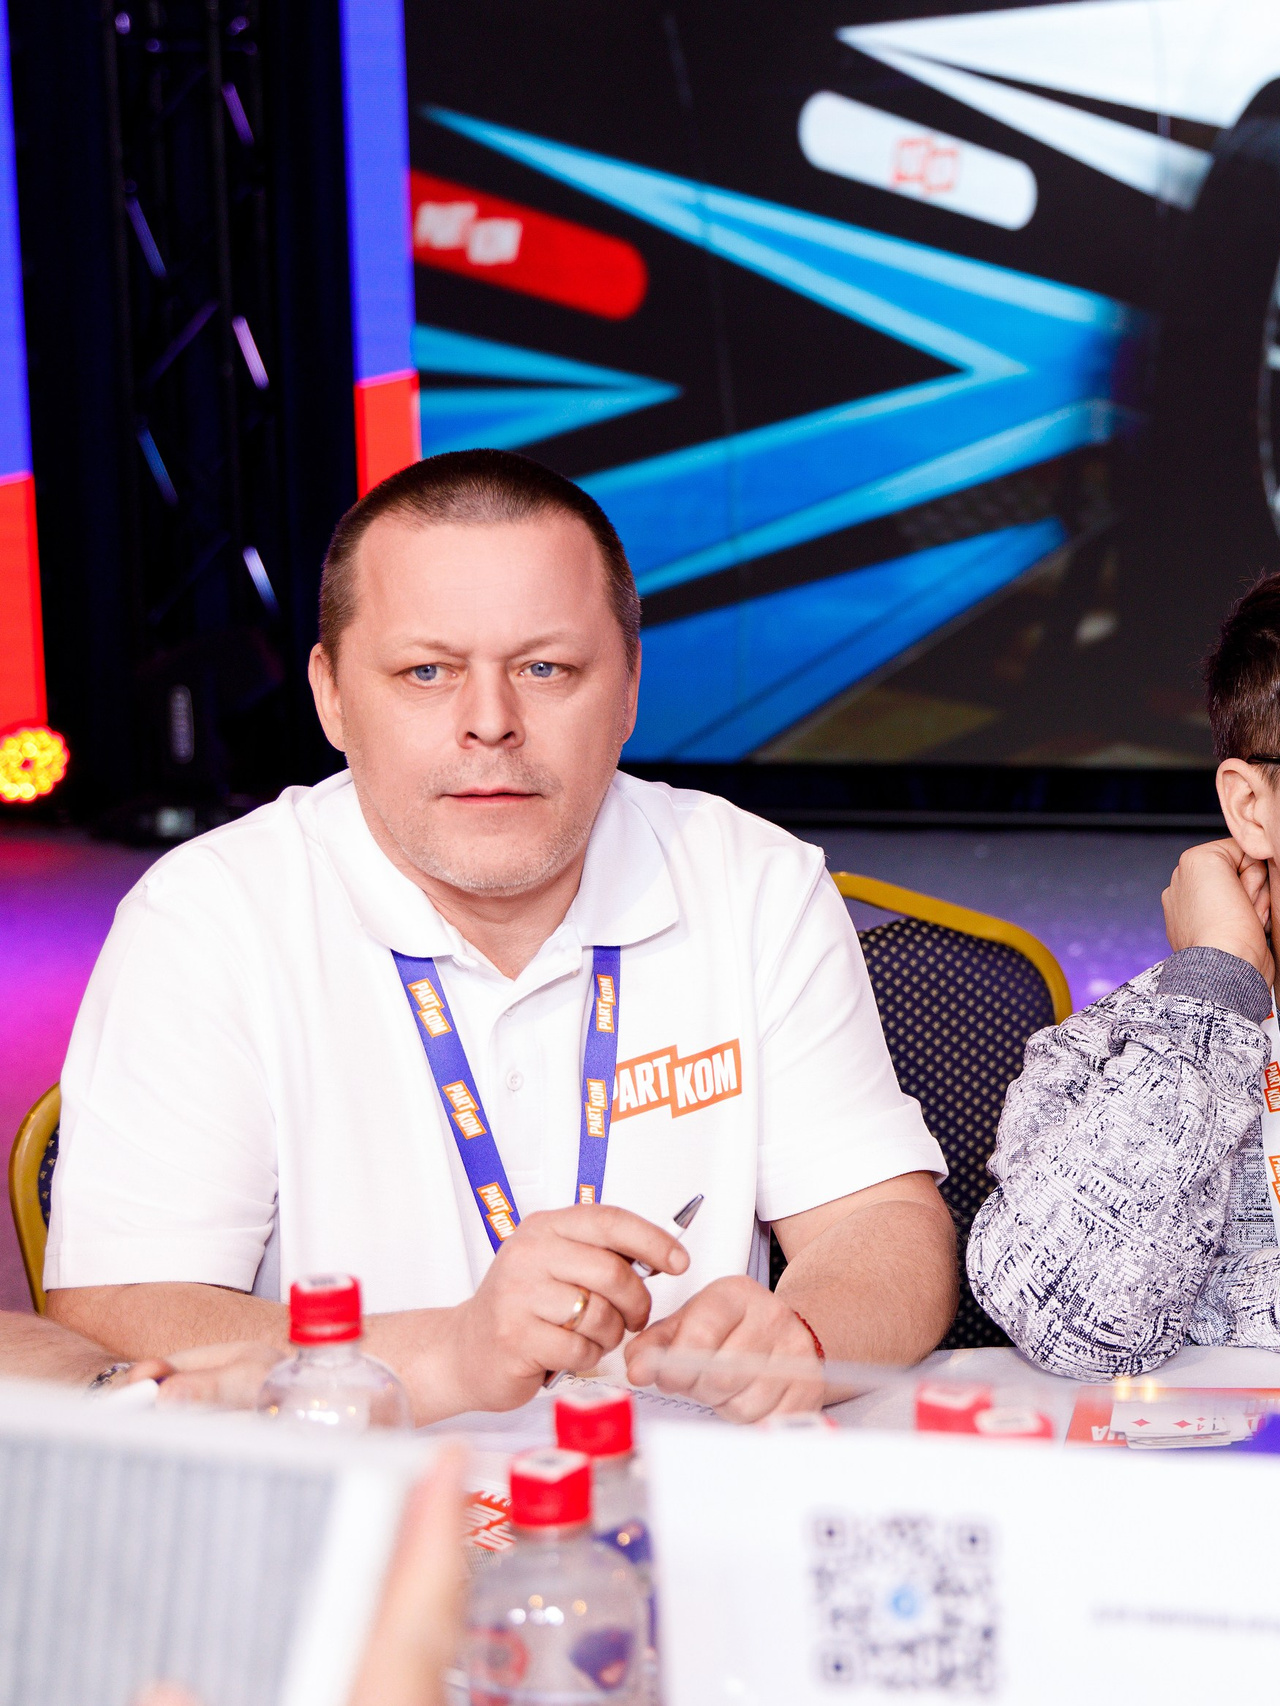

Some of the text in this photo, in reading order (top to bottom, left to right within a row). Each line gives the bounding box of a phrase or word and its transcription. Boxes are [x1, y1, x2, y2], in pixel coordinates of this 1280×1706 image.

[412, 979, 448, 1036] PART KOM
[598, 976, 614, 1031] PART KOM
[674, 1048, 738, 1109] KOM
[1266, 1064, 1280, 1089] PART
[446, 1082, 483, 1138] PART KOM
[588, 1080, 605, 1136] PART KOM
[480, 1184, 516, 1239] PART KOM
[581, 1186, 594, 1205] OM
